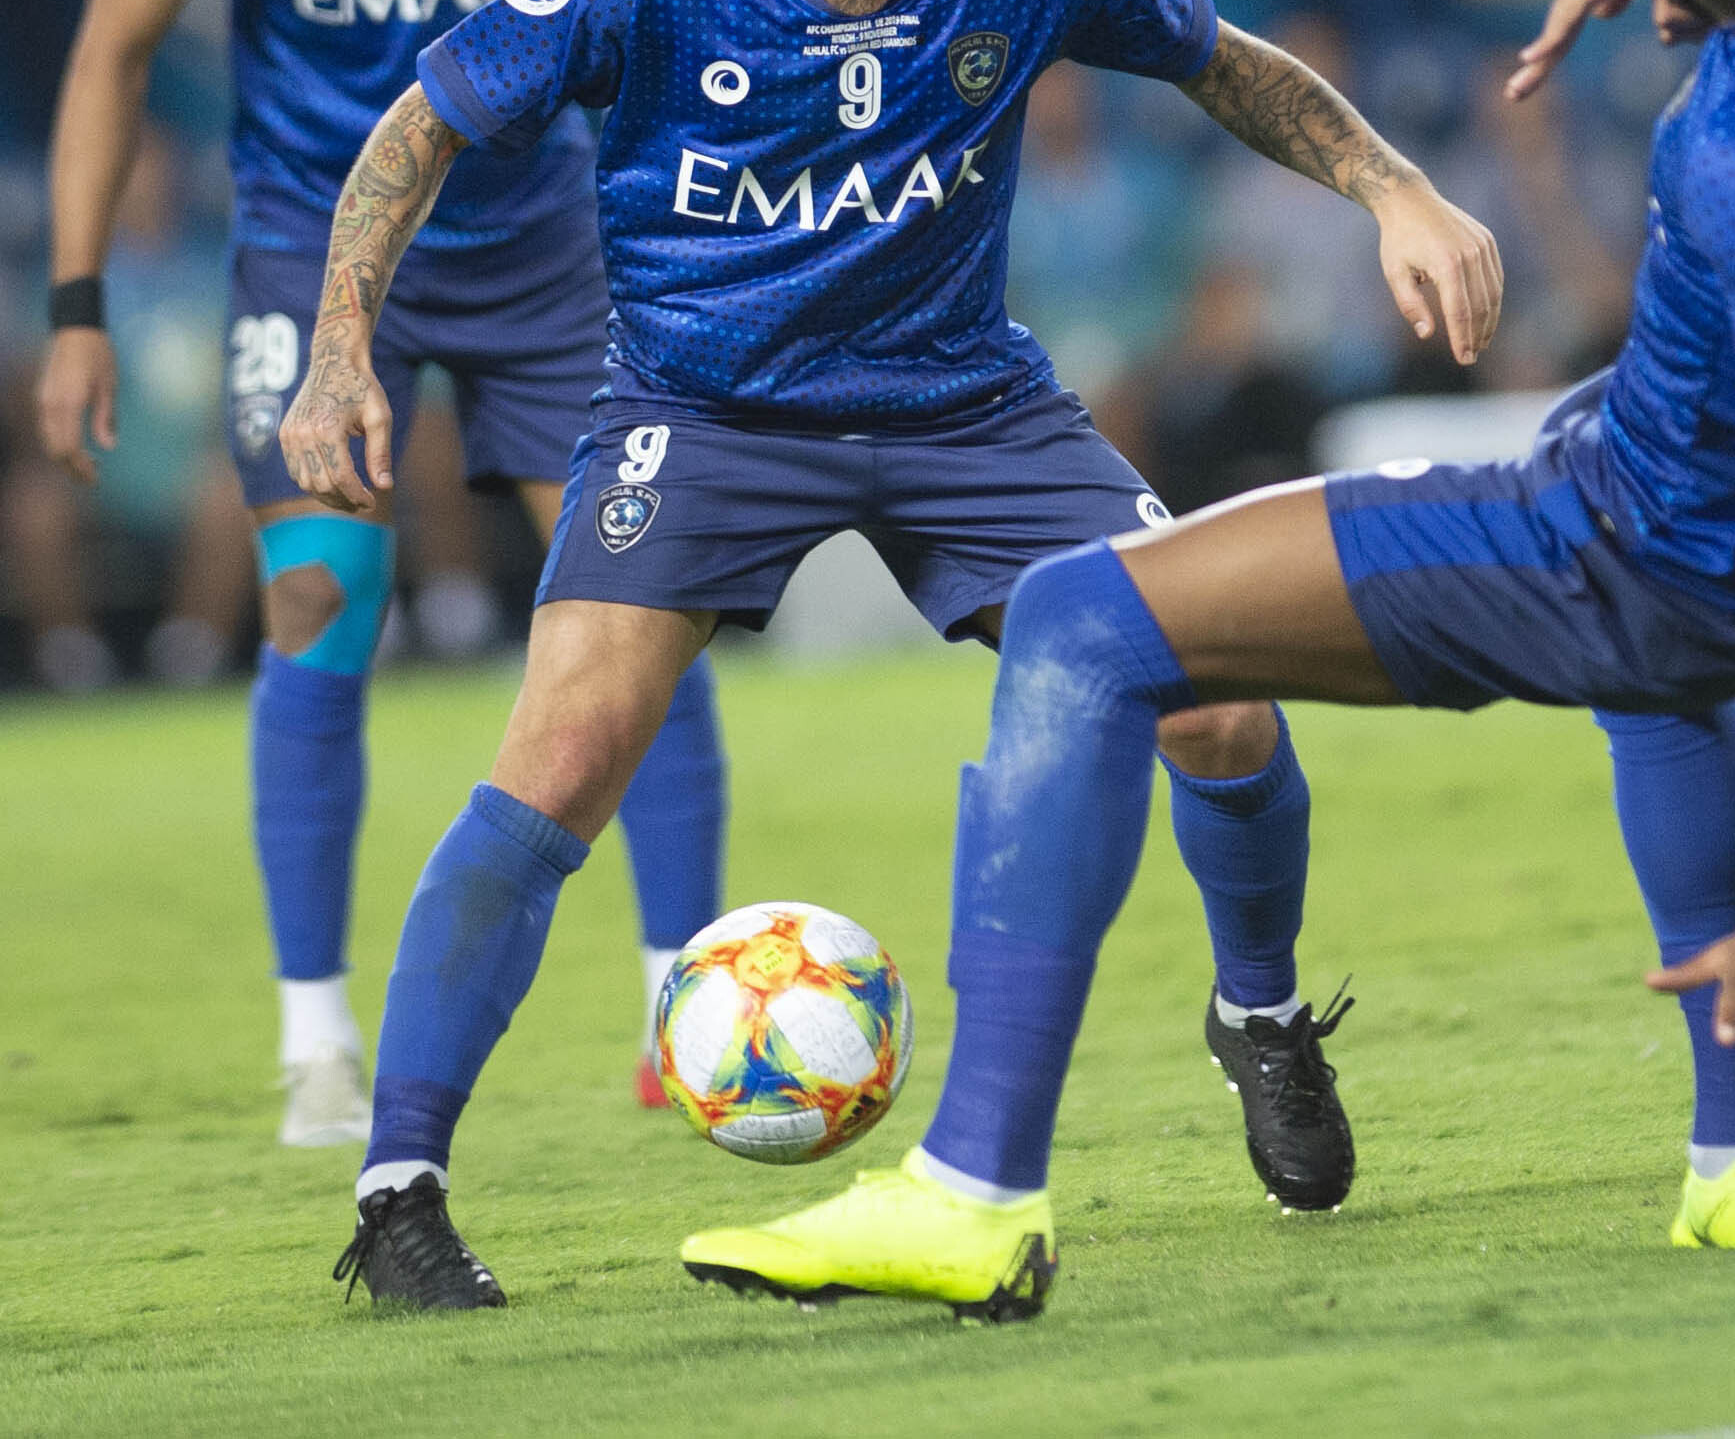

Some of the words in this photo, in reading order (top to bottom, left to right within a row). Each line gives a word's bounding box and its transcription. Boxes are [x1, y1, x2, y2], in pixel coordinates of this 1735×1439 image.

[860, 18, 884, 29] LEAUE
[838, 52, 882, 129] 9
[232, 312, 299, 396] 29
[617, 425, 671, 482] 9
